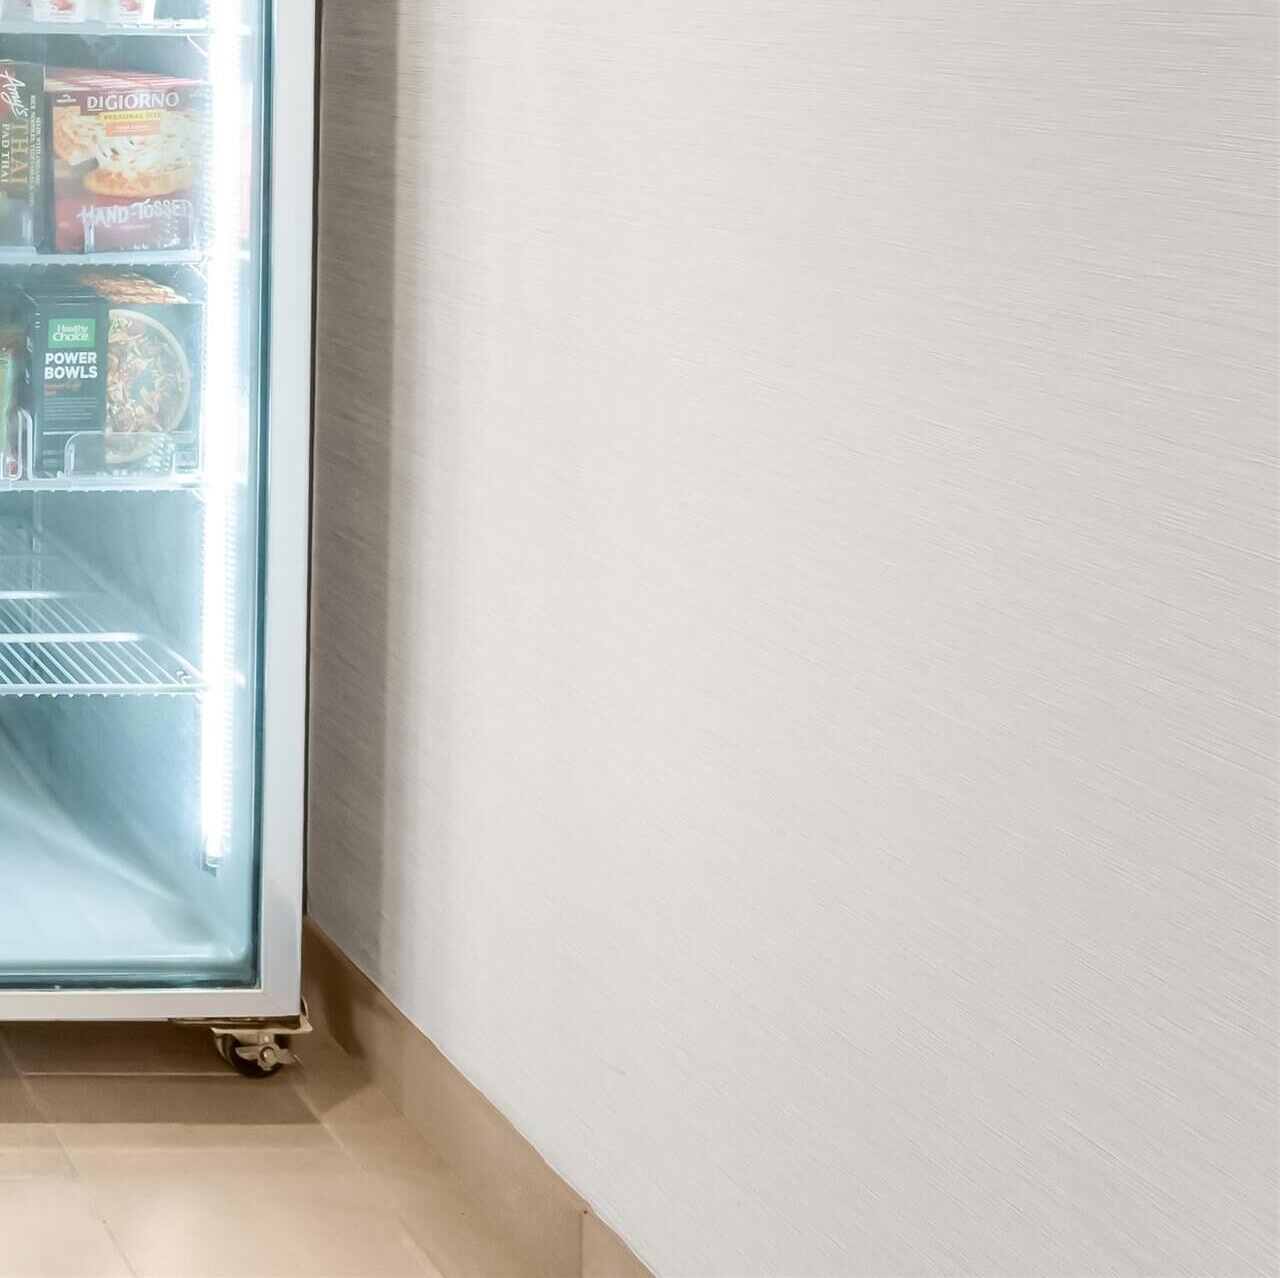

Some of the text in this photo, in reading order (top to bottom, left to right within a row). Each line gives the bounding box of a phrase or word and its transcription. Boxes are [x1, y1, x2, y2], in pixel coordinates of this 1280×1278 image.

[1, 123, 10, 148] PAD
[11, 123, 29, 184] THAI
[53, 331, 89, 342] Choice
[45, 352, 97, 364] POWER
[44, 366, 98, 379] BOWLS
